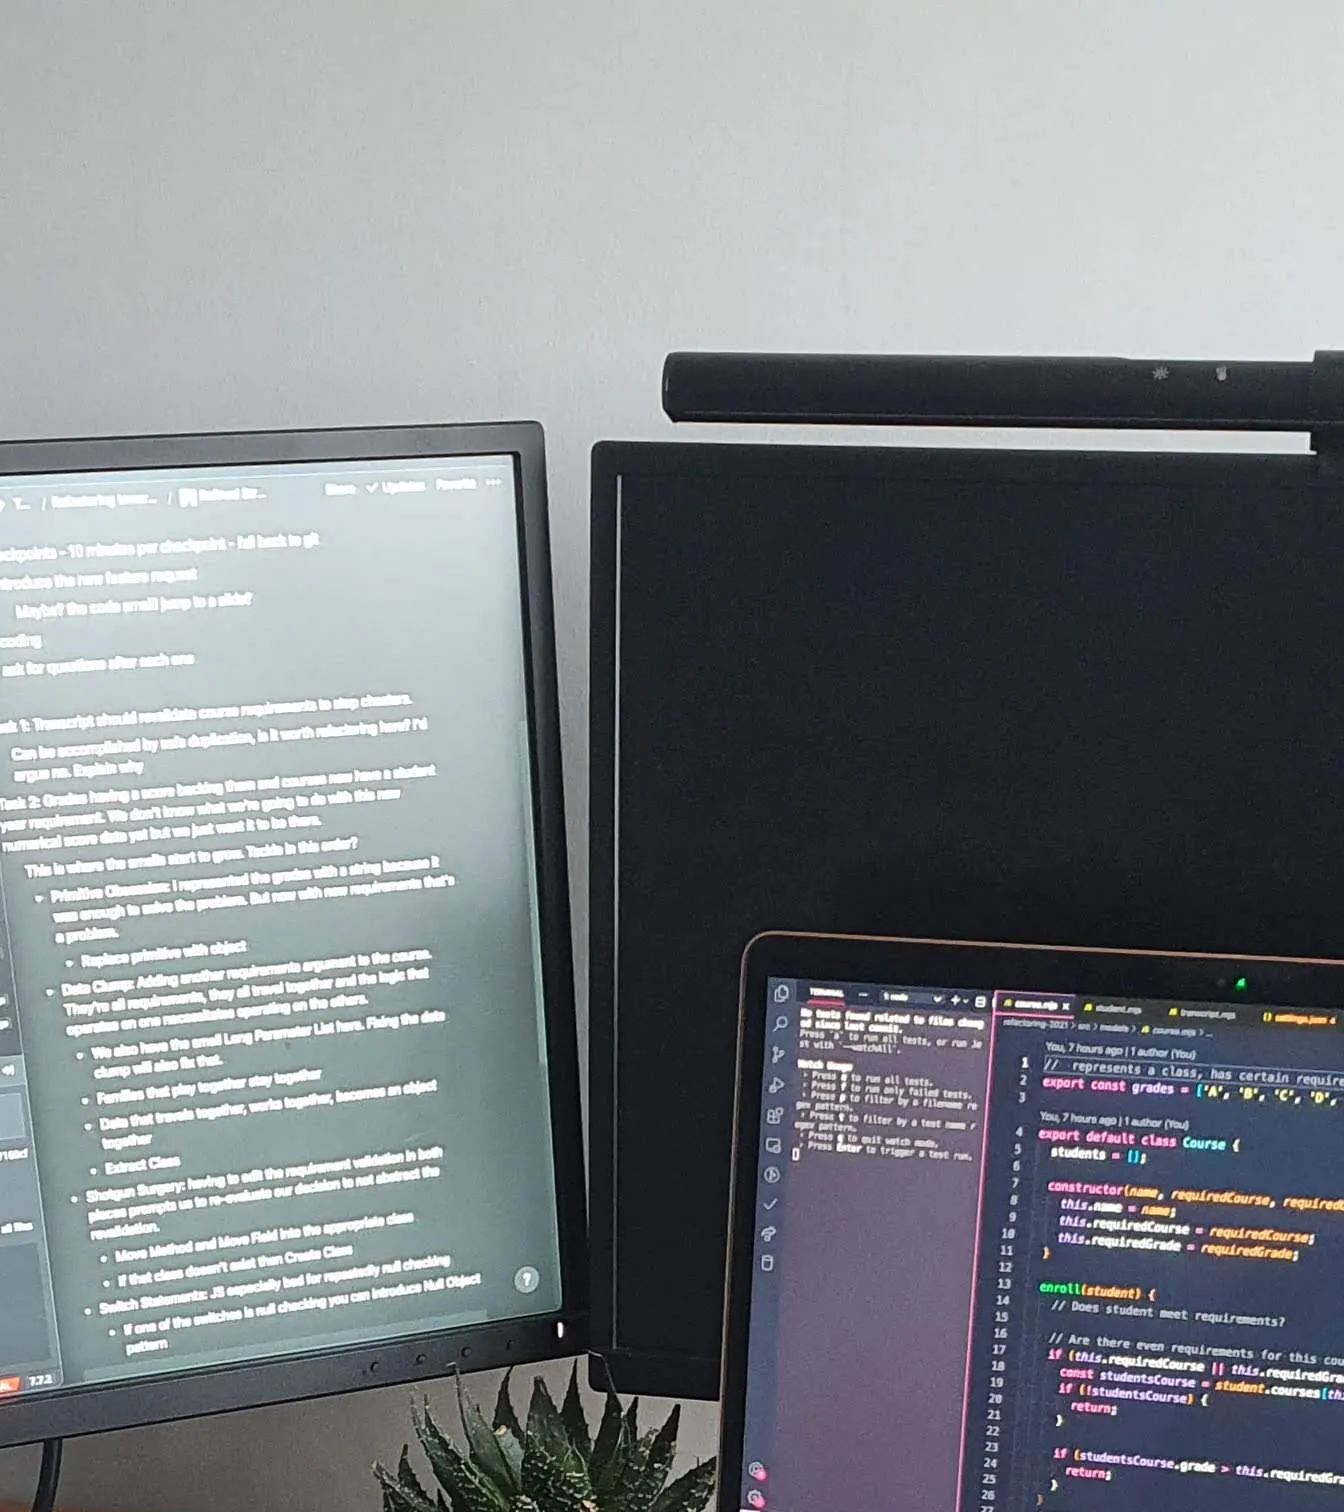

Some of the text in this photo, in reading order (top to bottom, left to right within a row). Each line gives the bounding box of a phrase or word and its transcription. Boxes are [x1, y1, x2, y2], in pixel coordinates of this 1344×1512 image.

[1073, 1059, 1141, 1076] represents
[1147, 1065, 1155, 1076] a
[1162, 1065, 1203, 1081] class,
[1211, 1068, 1232, 1080] has
[1239, 1069, 1289, 1084] certain
[1043, 1076, 1174, 1097] export const grades
[1038, 1127, 1226, 1151] export default class Course
[1050, 1146, 1106, 1161] students
[86, 1144, 443, 1205] Shotgun Surgery: having to edit the requirement validation in both
[105, 1154, 180, 1177] Extract Class
[1048, 1180, 1164, 1201] constructor(name,
[1171, 1187, 1276, 1208] requiredCourse,
[1039, 1280, 1142, 1302] enroll(student)
[1069, 1335, 1091, 1349] Are
[1097, 1336, 1131, 1353] there
[1136, 1340, 1164, 1355] even
[1171, 1339, 1254, 1361] requirements
[1261, 1348, 1282, 1362] for
[1289, 1349, 1319, 1365] this
[1099, 1368, 1196, 1390] studentsCourse
